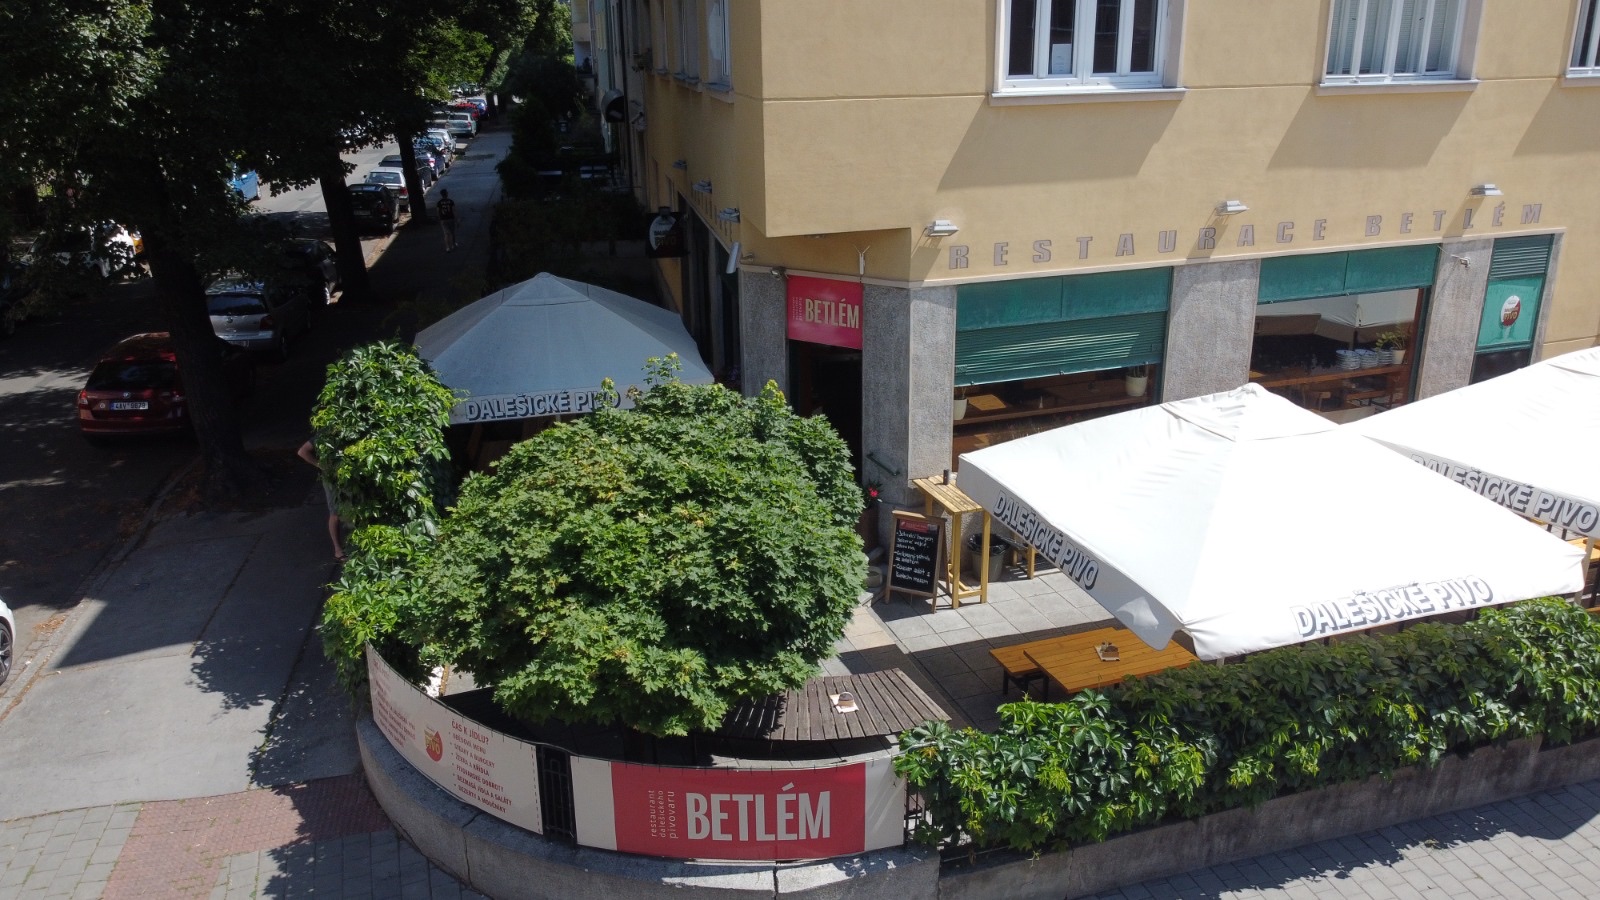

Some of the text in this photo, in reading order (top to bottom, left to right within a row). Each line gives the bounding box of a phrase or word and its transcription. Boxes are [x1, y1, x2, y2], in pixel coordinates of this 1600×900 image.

[949, 201, 1542, 269] RESTAURACE BETLÉM
[805, 298, 859, 329] BETLÉM
[465, 390, 571, 421] DALEŠICKÉ
[1411, 453, 1599, 533] EŠICKÉ PIVO
[993, 490, 1099, 590] DALEŠICKÉ PIVO
[1289, 575, 1494, 638] DALEŠICKÉ PIVO
[451, 719, 463, 732] ČAS
[469, 729, 489, 745] JÍDLU?
[648, 790, 657, 837] restaurant
[667, 791, 679, 839] pivovaru
[685, 782, 831, 841] BETLÉM
